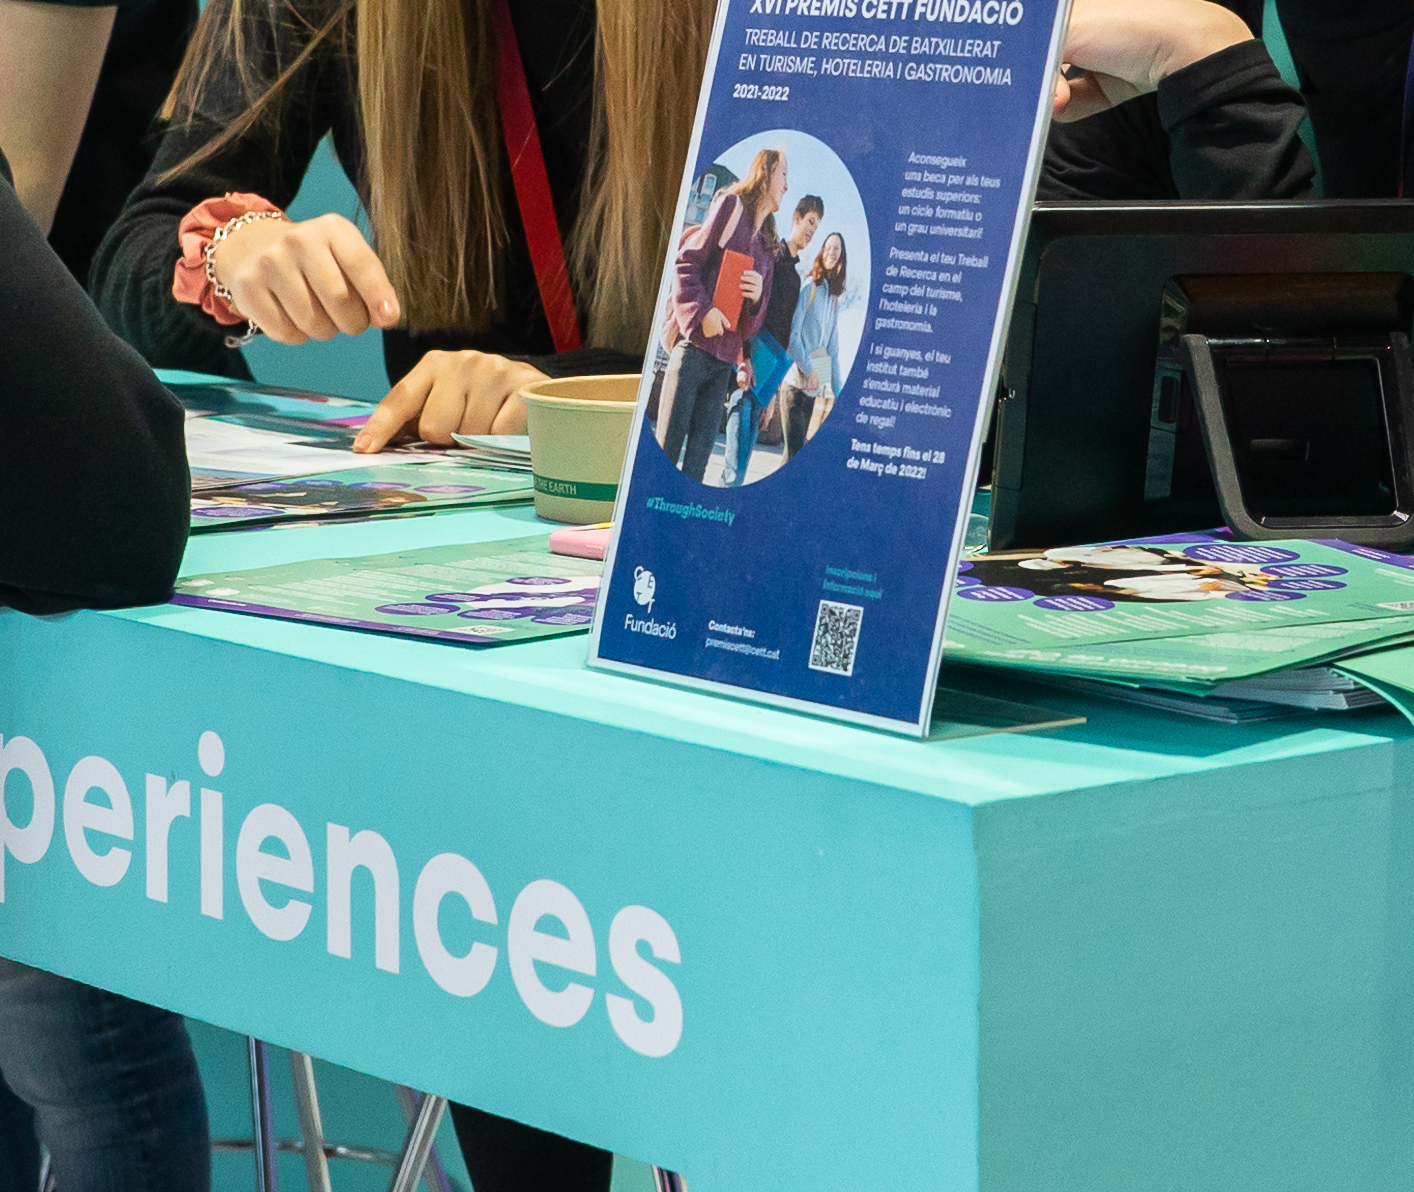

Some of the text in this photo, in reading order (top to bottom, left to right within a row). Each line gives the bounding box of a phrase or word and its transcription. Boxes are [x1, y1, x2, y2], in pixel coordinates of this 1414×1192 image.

[745, 28, 1002, 58] TREBALL DE RECERCA DE BATXILLERAT
[738, 53, 1012, 85] EN TURISME, HOTELERIA I GASTRONOMIA
[733, 83, 790, 101] 2021-2022
[908, 151, 967, 169] Aconsegueix
[904, 171, 922, 181] una
[923, 170, 946, 183] beca
[947, 174, 965, 186] per
[980, 175, 1001, 188] teus
[902, 187, 935, 199] estudis
[898, 204, 982, 221] un cicle formatiu o
[895, 222, 907, 232] un
[907, 223, 928, 236] grau
[889, 246, 989, 268] Presenta el teu Treball
[886, 264, 962, 283] de Recerca en el
[882, 283, 963, 302] camp del turisme,
[875, 317, 933, 333] gastronomia.
[875, 343, 884, 355] si
[924, 349, 935, 362] el
[935, 351, 952, 364] teu
[866, 360, 929, 379] institut també
[901, 383, 941, 398] material
[859, 395, 899, 410] educatiu
[855, 411, 868, 424] de
[851, 438, 871, 453] Tens
[873, 442, 902, 459] temps
[903, 446, 921, 461] fins
[922, 449, 932, 462] el
[846, 456, 927, 479] de Març de 2022!
[549, 481, 577, 495] EARTH
[646, 496, 735, 526] #ThroughSociety
[624, 613, 677, 640] Fundació
